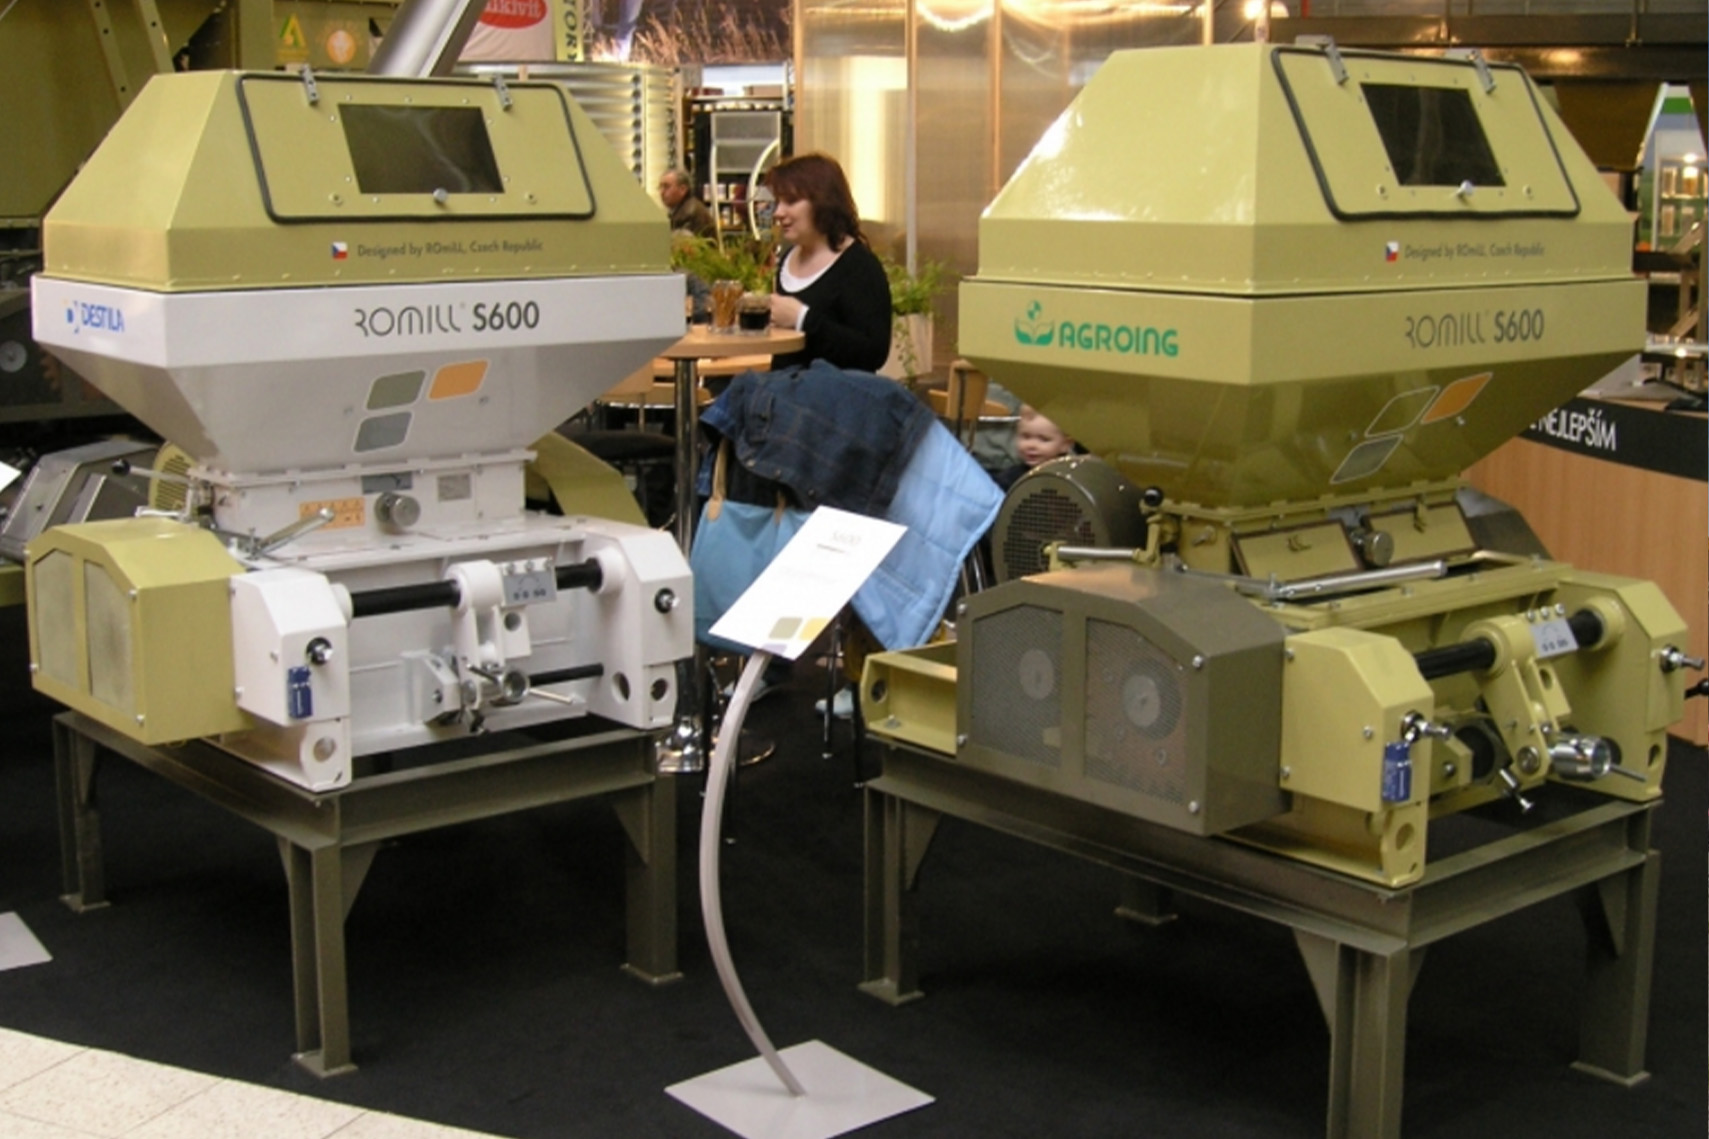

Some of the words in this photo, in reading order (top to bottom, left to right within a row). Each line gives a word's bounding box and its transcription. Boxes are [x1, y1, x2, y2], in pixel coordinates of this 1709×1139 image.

[357, 243, 406, 260] Designed
[409, 241, 424, 258] by
[469, 239, 499, 254] Czech
[502, 238, 543, 255] Republic
[472, 300, 541, 333] S600
[1493, 308, 1546, 343] S600
[1058, 320, 1180, 358] AGROING
